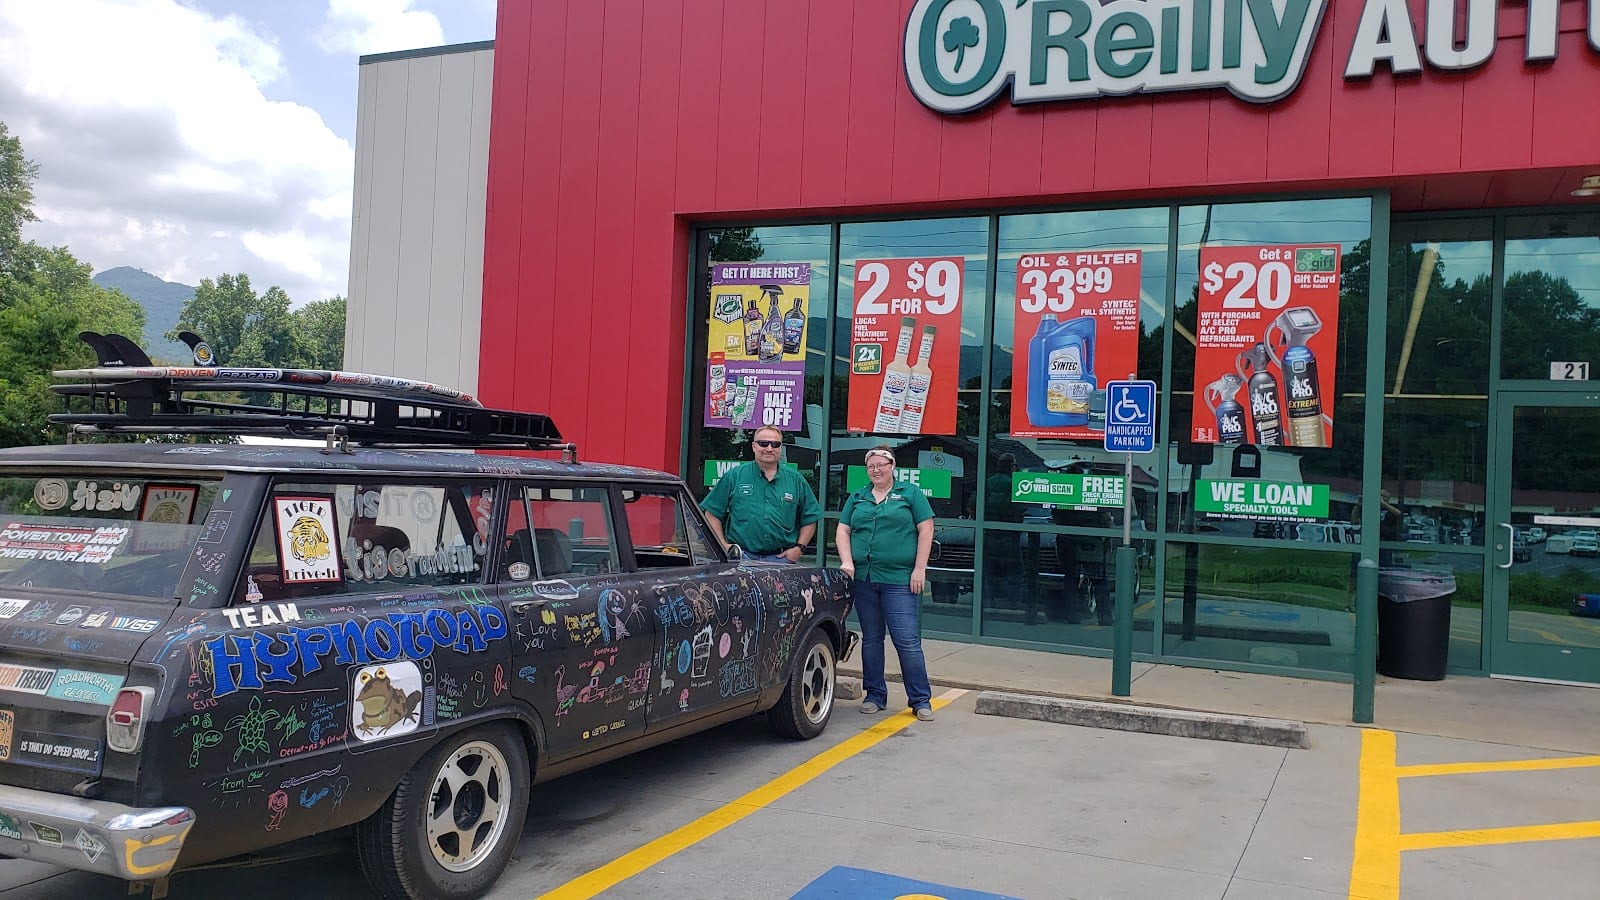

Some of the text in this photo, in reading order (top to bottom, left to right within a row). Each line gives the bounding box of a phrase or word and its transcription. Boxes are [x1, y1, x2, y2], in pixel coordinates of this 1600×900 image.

[919, 0, 1600, 96] O'Reilly AUT
[1020, 253, 1137, 267] OIL & FILTER
[1260, 249, 1291, 260] Get a
[1312, 257, 1334, 271] gift
[722, 266, 800, 278] GET IT HERE FIRST
[1294, 274, 1336, 284] Gift Card
[856, 260, 960, 315] 2 FOR $9
[1203, 262, 1291, 309] $20
[1052, 360, 1078, 370] SYNTEC
[1564, 363, 1586, 380] 21
[168, 369, 216, 377] DRIVEN
[744, 376, 758, 386] GET
[764, 393, 792, 408] HALF
[1288, 398, 1319, 408] EXTREME
[1253, 402, 1278, 416] PRO
[762, 408, 792, 426] OFF
[1108, 426, 1152, 435] HANDICAPPED
[1114, 436, 1145, 446] PARKING
[1033, 484, 1072, 494] VERI SCAN
[1082, 476, 1124, 493] FREE
[1211, 482, 1312, 506] WE LOAN
[284, 502, 327, 519] TIGER
[1224, 504, 1298, 515] SPECIALTY TOOLS
[0, 530, 51, 542] POWER
[52, 532, 91, 544] TOUR
[0, 548, 36, 560] OWER
[38, 551, 79, 562] TOUR
[0, 601, 21, 616] Tube
[223, 603, 302, 628] TEAM
[124, 618, 159, 630] VGG
[206, 605, 508, 698] HYPNOTOAD
[15, 669, 54, 690] TREND
[56, 672, 115, 694] ROADWORTHY
[20, 741, 27, 751] IS
[28, 742, 44, 753] THAT
[53, 745, 72, 758] SPEED
[220, 778, 244, 790] from
